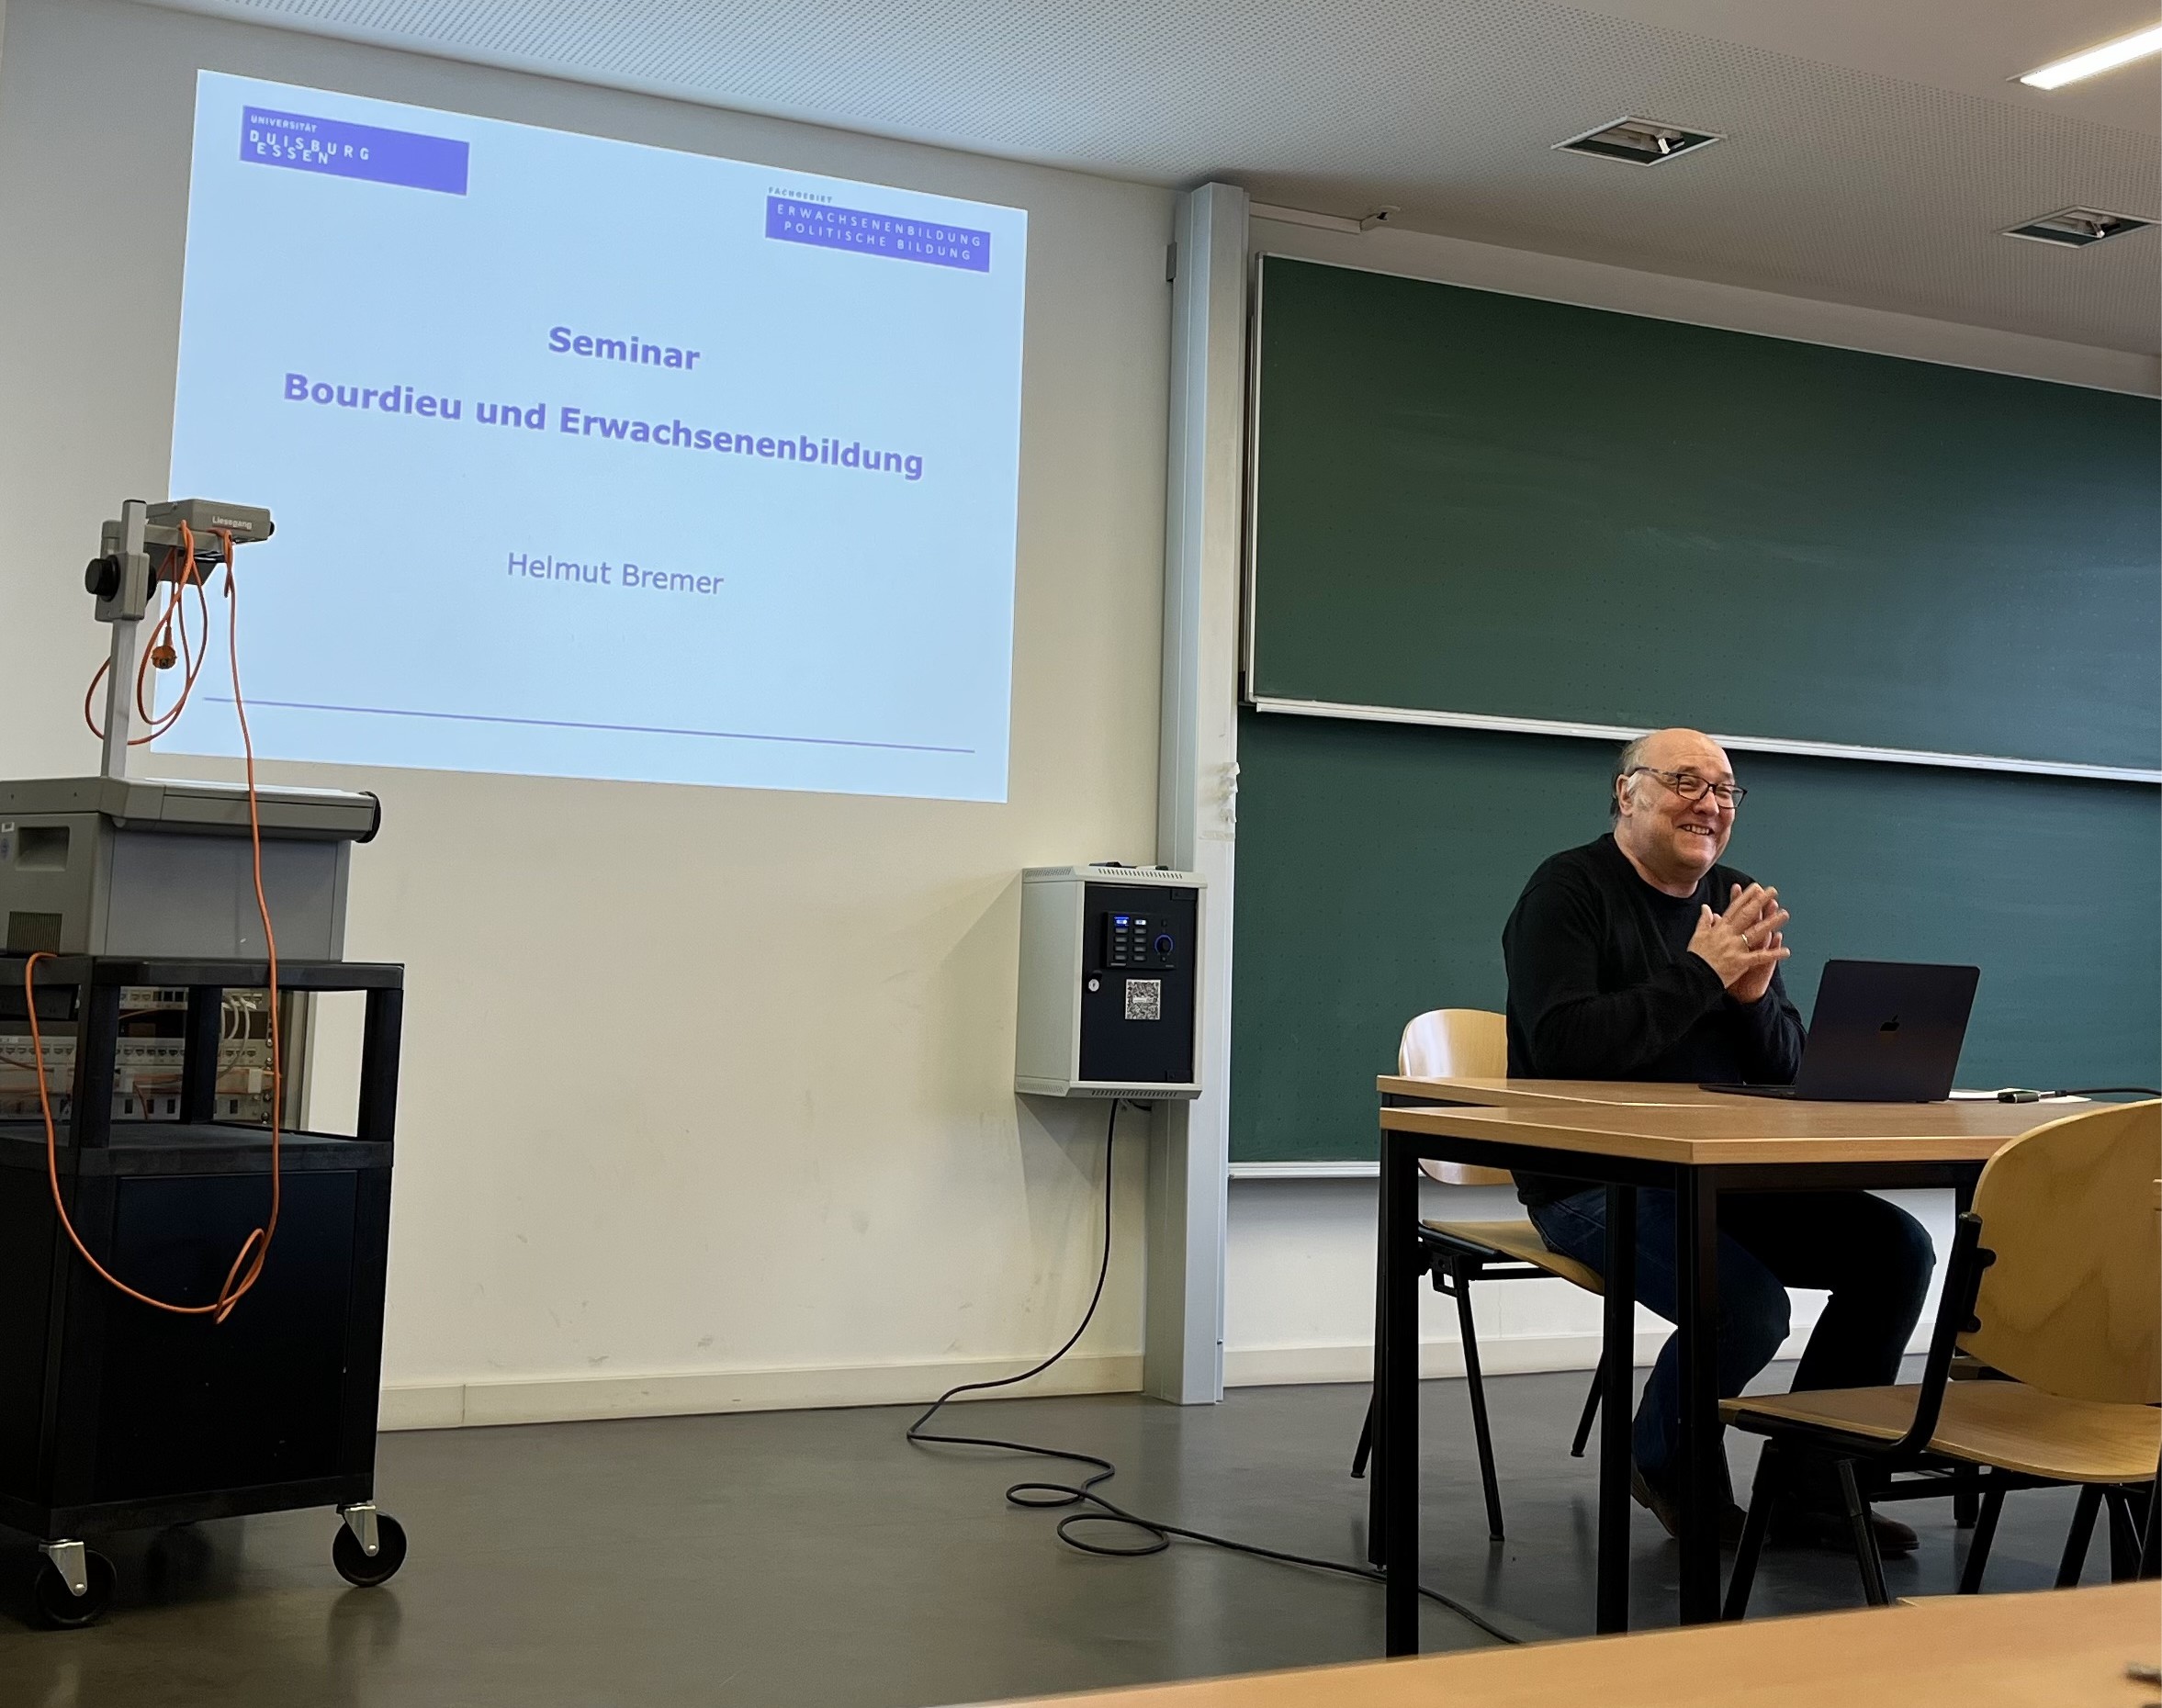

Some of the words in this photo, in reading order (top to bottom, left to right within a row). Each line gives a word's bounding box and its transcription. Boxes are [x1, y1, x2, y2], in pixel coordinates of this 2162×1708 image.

[251, 115, 318, 133] UNIVERSITÄT
[250, 129, 370, 161] DUISBURG
[256, 142, 329, 165] ESSEN
[768, 186, 833, 204] FACHGEBIET
[777, 203, 981, 247] ERWACHSENENBILDUNG
[784, 220, 886, 247] POLITISCHE
[896, 239, 971, 261] BILDUNG
[548, 326, 701, 370] Seminar
[284, 373, 462, 421] Bourdieu
[476, 402, 546, 431] und
[560, 406, 923, 481] Erwachsenenbildung
[508, 552, 613, 585] Helmut
[622, 563, 725, 595] Bremer
